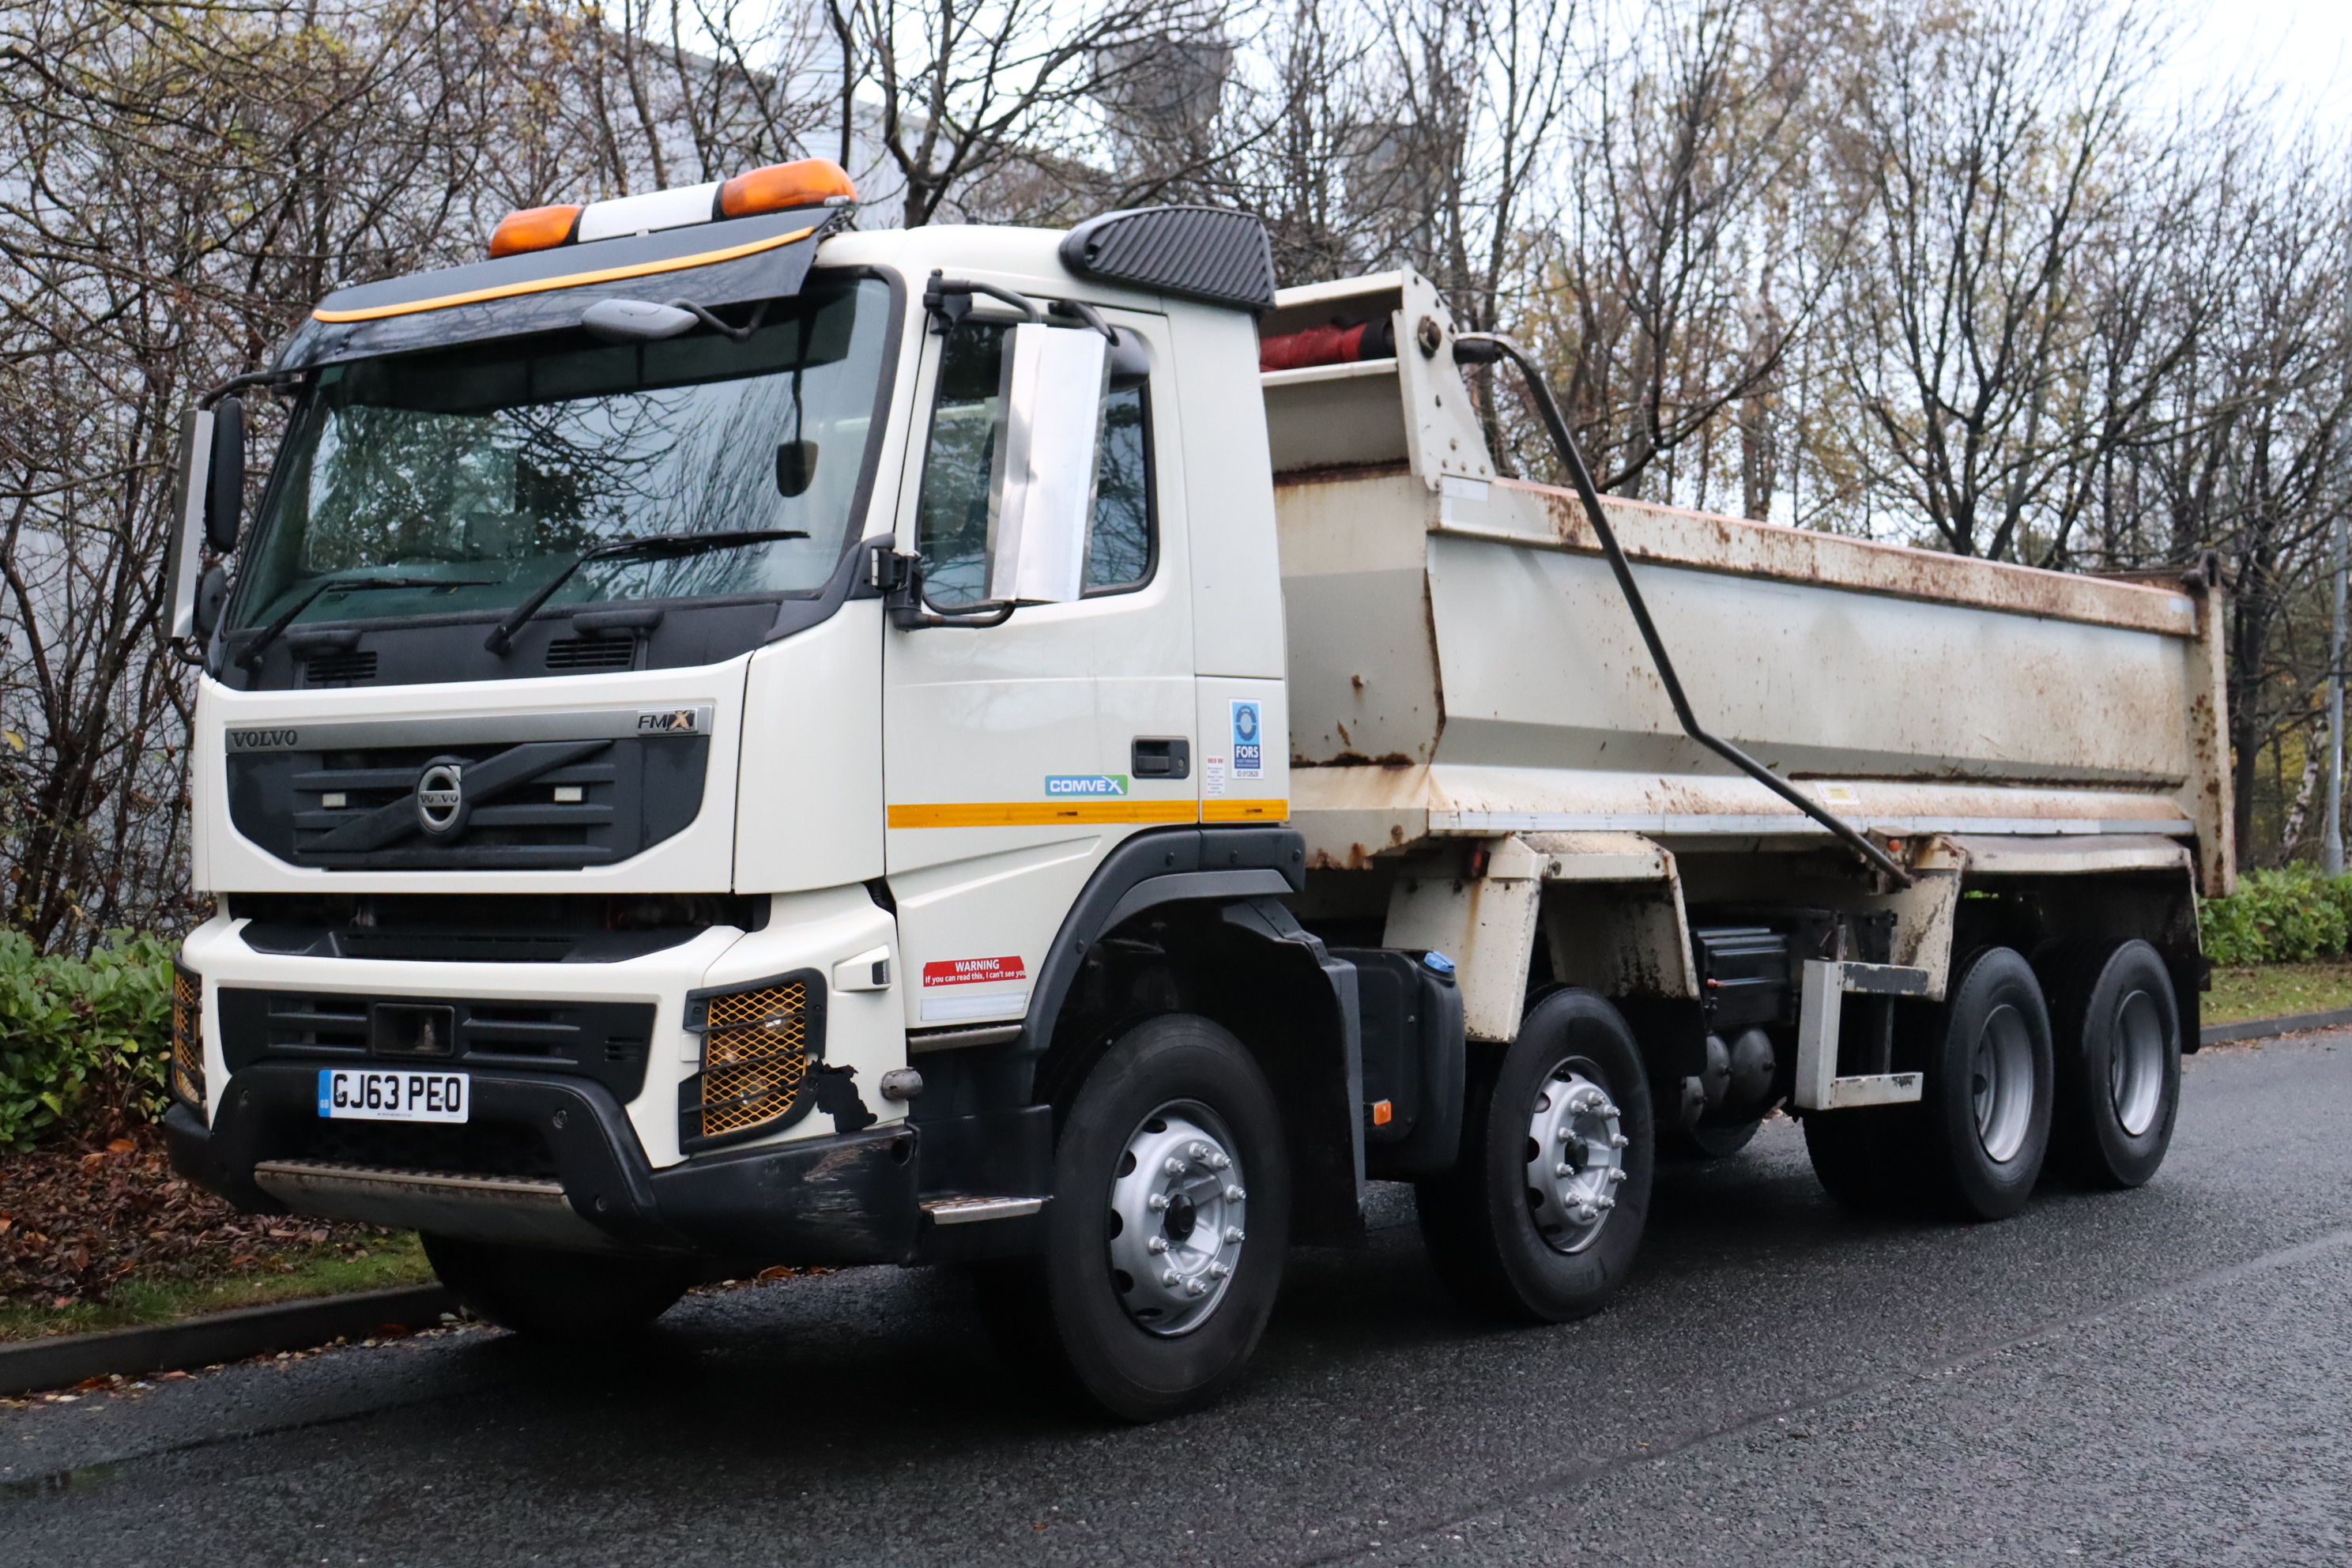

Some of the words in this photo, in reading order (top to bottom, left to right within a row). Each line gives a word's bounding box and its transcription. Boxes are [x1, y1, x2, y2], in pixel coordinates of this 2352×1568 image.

[638, 710, 695, 731] FMX
[232, 730, 298, 747] VOLVO
[1236, 746, 1258, 758] FORS
[1050, 776, 1124, 794] COMVEX
[420, 794, 459, 803] VOVO
[955, 959, 1000, 972] WARNING
[957, 972, 971, 981] read
[971, 971, 985, 980] this,
[334, 1073, 399, 1110] GJ63
[409, 1076, 461, 1112] PEO
[320, 1099, 329, 1109] GB
